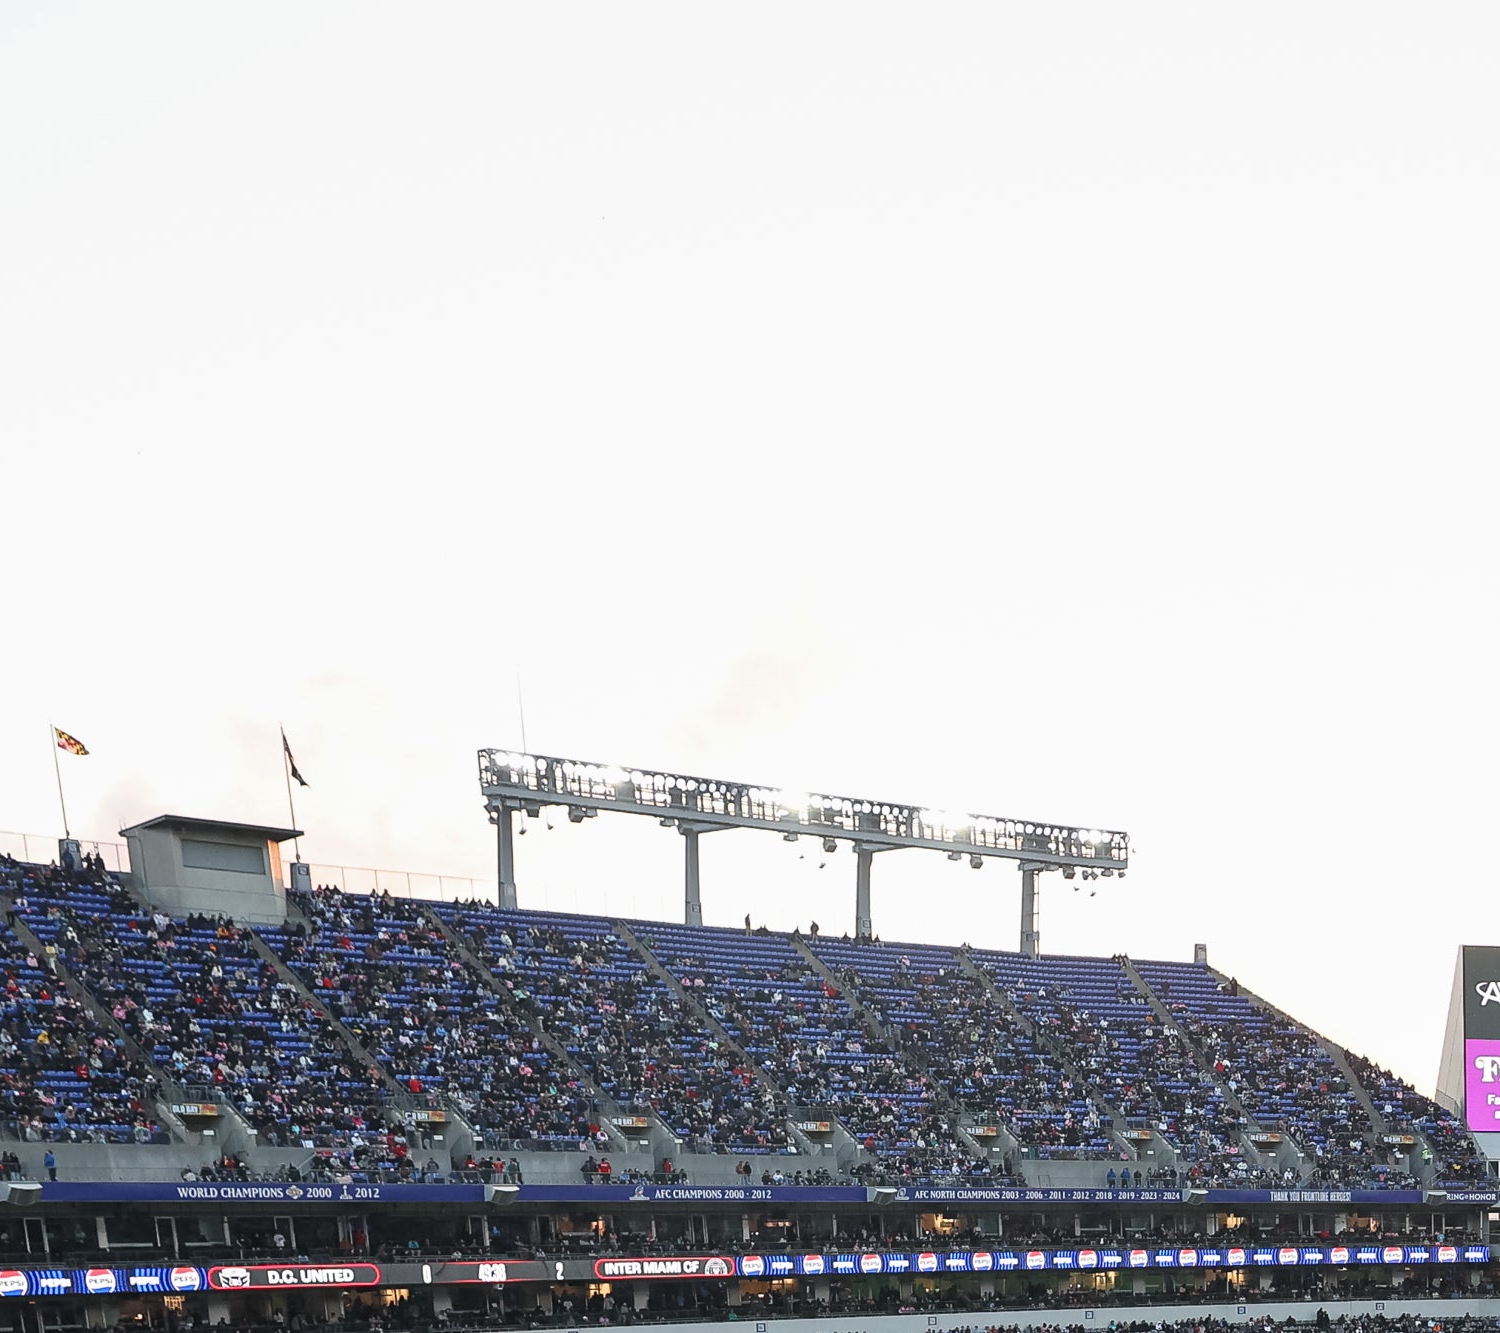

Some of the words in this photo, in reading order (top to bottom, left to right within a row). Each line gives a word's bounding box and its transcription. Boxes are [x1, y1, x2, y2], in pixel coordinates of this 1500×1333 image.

[177, 1187, 218, 1199] WORLD
[220, 1187, 284, 1199] CHAMPIONS
[306, 1187, 333, 1199] 2000
[355, 1187, 381, 1199] 2012
[655, 1189, 673, 1200] AFC
[673, 1189, 723, 1200] CHAMPIONS
[724, 1189, 745, 1200] 2000
[751, 1189, 773, 1200] 2012
[915, 1191, 929, 1200] AFC
[930, 1191, 956, 1200] NORTH
[957, 1191, 1001, 1200] CHAMPIONS
[1002, 1191, 1020, 1200] 2003
[1025, 1191, 1043, 1200] 2006
[1049, 1191, 1067, 1200] 2011
[1072, 1191, 1090, 1200] 2012
[1095, 1191, 1113, 1200] 2018
[1118, 1191, 1136, 1200] 2019
[1140, 1191, 1158, 1200] 2023
[1162, 1191, 1181, 1200] 2024
[1469, 1193, 1497, 1201] HONOR
[422, 1264, 431, 1283] 0
[555, 1262, 564, 1280] 2
[605, 1262, 642, 1276] INTER
[644, 1262, 681, 1275] MIAMI
[301, 1269, 354, 1283] UNITED
